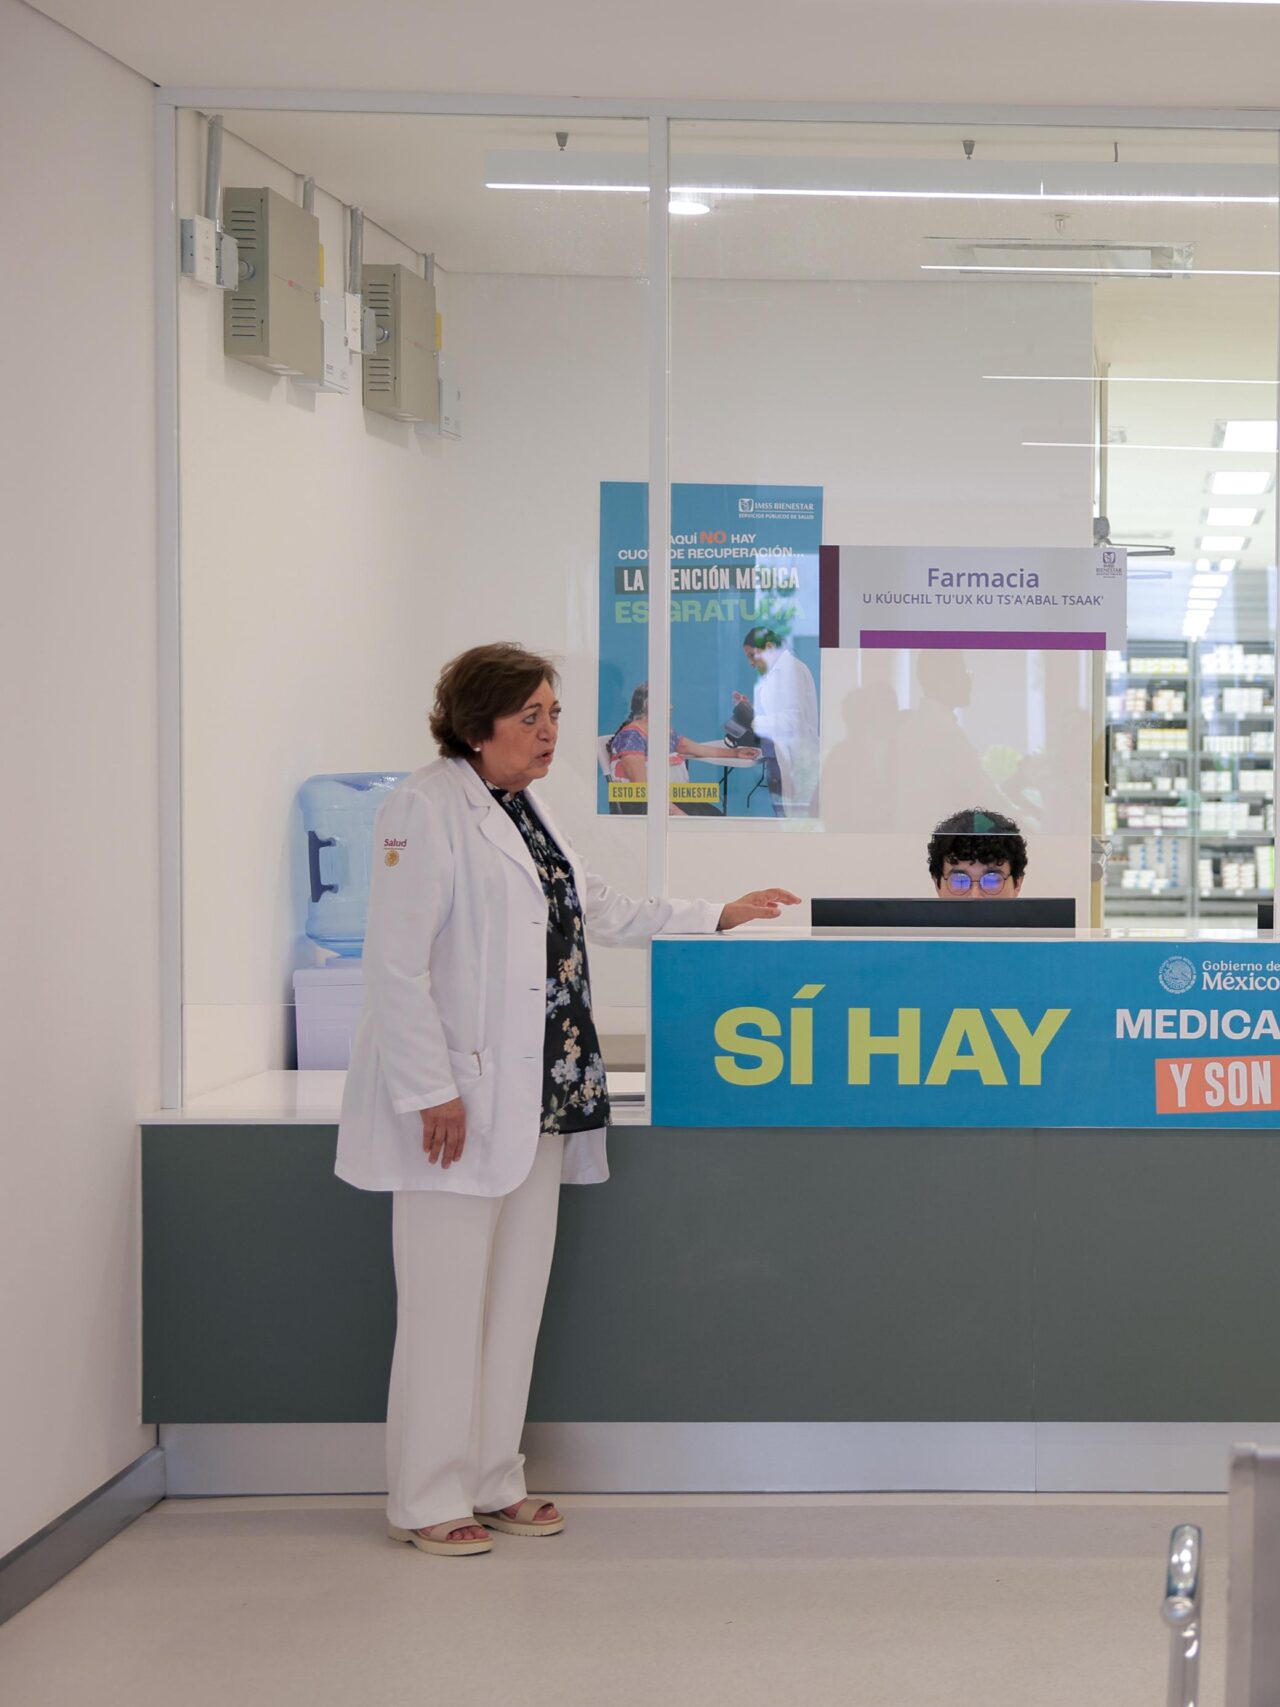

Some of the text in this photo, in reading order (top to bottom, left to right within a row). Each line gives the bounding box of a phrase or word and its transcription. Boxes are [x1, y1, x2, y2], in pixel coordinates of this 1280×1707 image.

[754, 502, 815, 511] IMSS BIENESTAR
[701, 530, 727, 545] NO
[731, 534, 756, 544] HAY
[669, 548, 685, 559] DE
[623, 569, 645, 591] LA
[736, 566, 800, 589] MÉDICA
[928, 568, 1039, 588] Farmacia
[863, 593, 872, 604] U
[875, 591, 932, 604] KÚUCHIL
[936, 593, 973, 605] TU'UX
[976, 594, 994, 605] KU
[998, 594, 1058, 606] TS'A'ABAL
[615, 601, 649, 624] ES
[612, 787, 718, 798] ESTO ES BIENESTAR
[383, 838, 408, 847] Salud
[1202, 960, 1280, 971] Gobierno de
[1202, 971, 1280, 991] México
[714, 984, 1071, 1086] SÍ HAY
[1169, 1063, 1193, 1108] Y
[1204, 1060, 1272, 1107] SON
